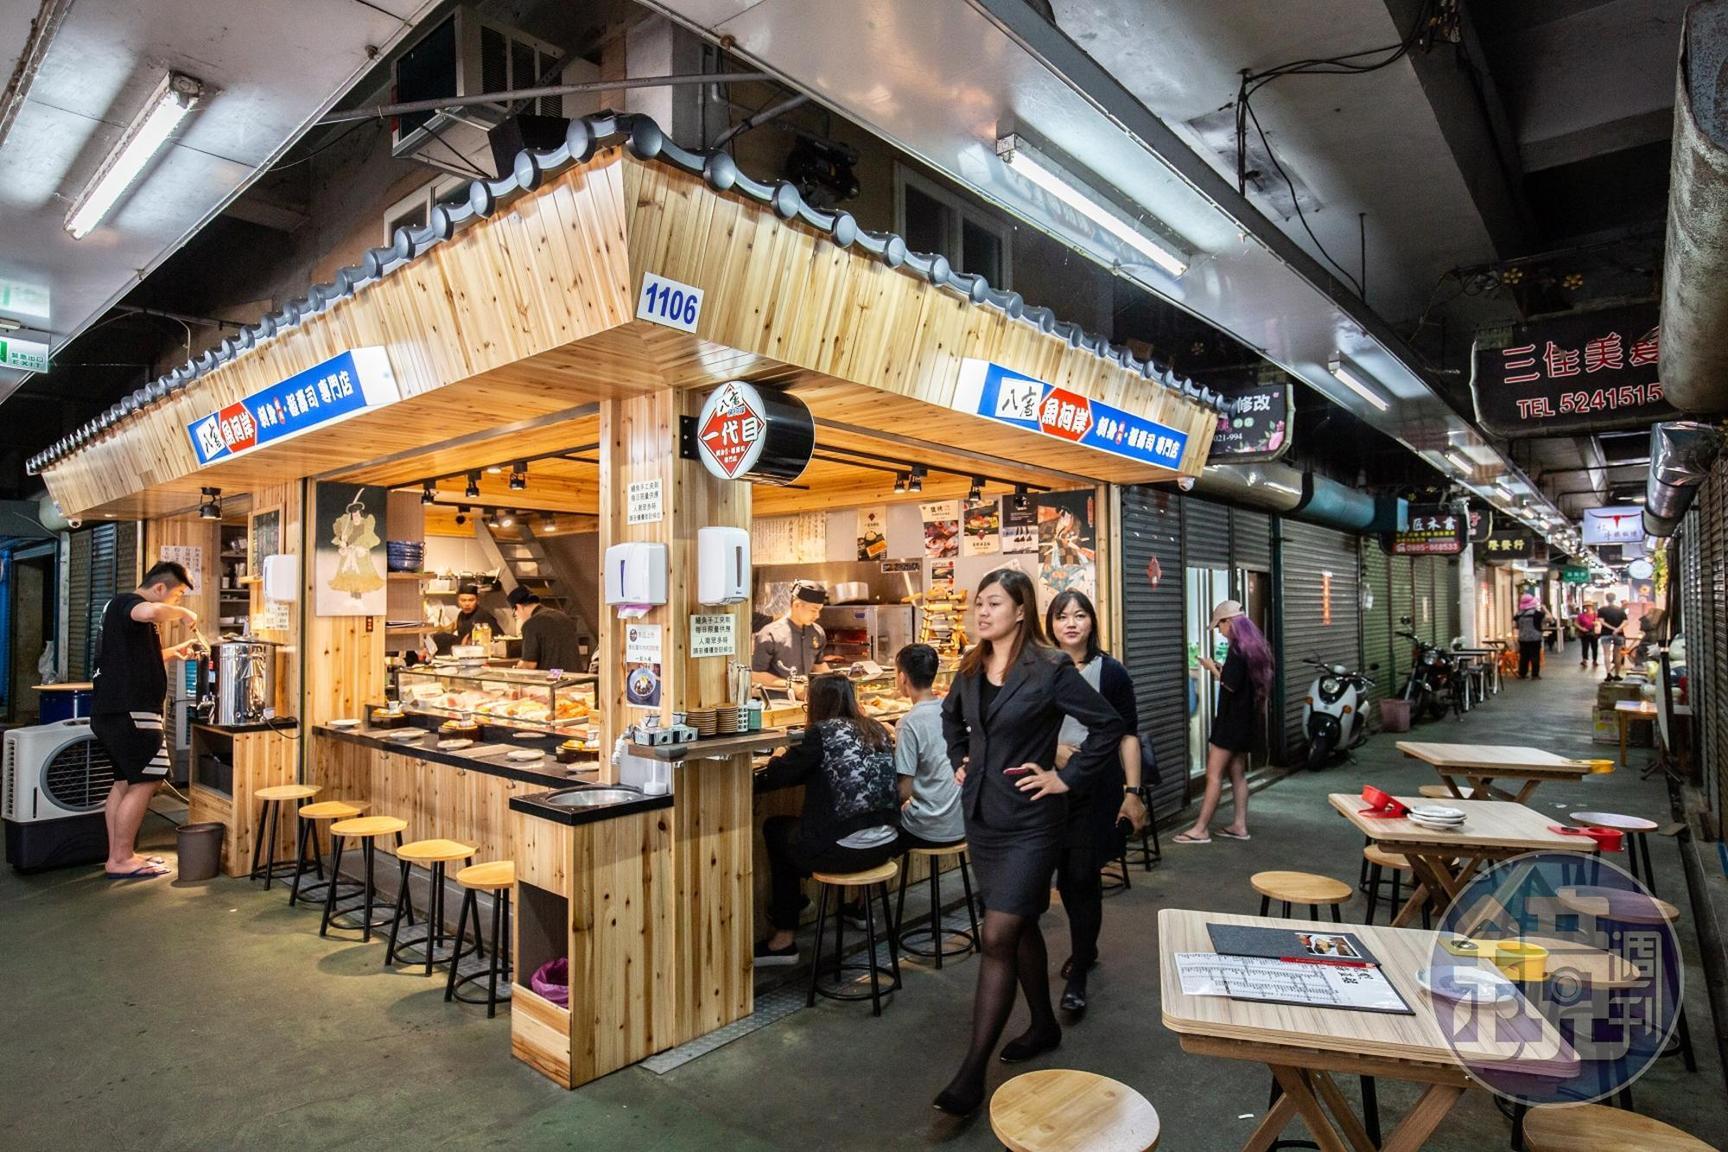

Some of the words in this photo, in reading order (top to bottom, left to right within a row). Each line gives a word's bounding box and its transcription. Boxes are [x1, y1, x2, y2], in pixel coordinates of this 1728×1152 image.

[646, 282, 698, 325] 1106
[12, 359, 41, 368] EXIT
[221, 411, 255, 444] 魚河岸
[317, 370, 354, 403] 專門店
[1237, 394, 1271, 413] 修改
[1517, 399, 1556, 420] TEL
[1559, 383, 1664, 414] 5241515
[702, 417, 758, 446] 一代目
[1042, 397, 1088, 433] 魚河岸
[1155, 436, 1181, 459] 專門店
